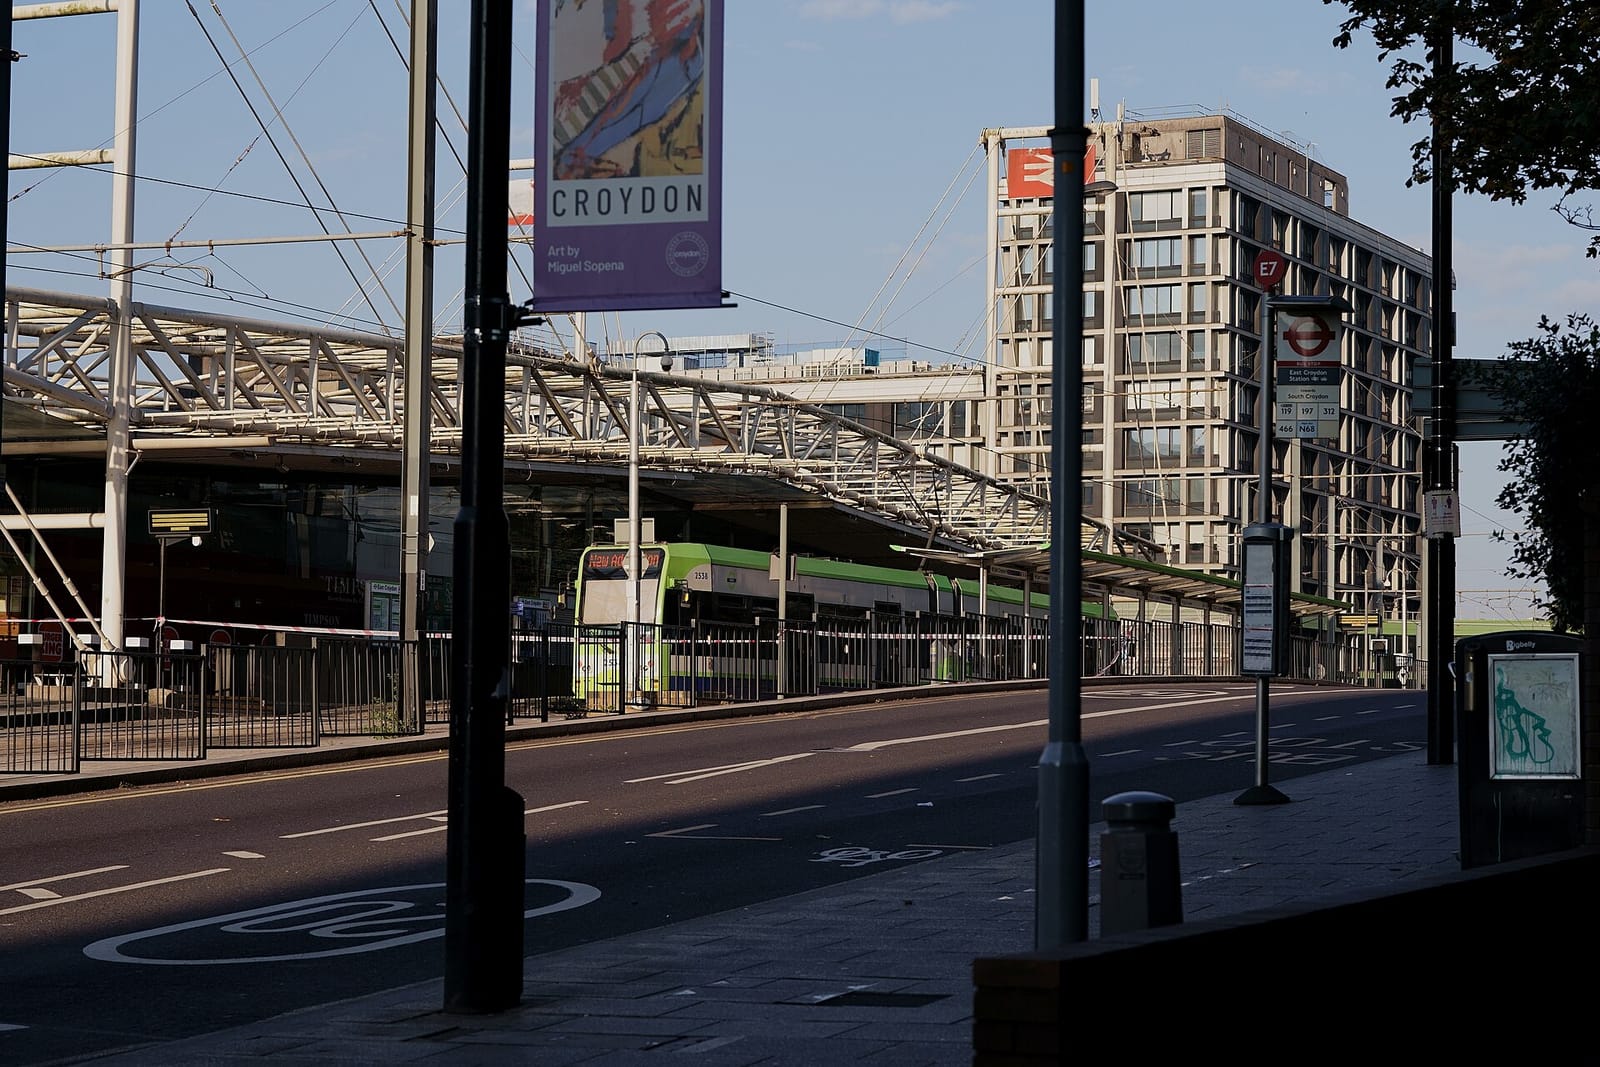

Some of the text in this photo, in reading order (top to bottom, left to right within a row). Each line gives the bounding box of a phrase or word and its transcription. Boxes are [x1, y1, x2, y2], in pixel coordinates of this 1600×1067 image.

[553, 184, 702, 217] CROYDON
[548, 245, 580, 259] Art by
[548, 260, 625, 275] Miguel Sopena
[1260, 261, 1278, 276] E7
[1303, 369, 1328, 377] Croydon
[1281, 407, 1335, 415] 119 197 312
[1279, 425, 1315, 433] 466 N68
[304, 612, 341, 625] TIMPSON
